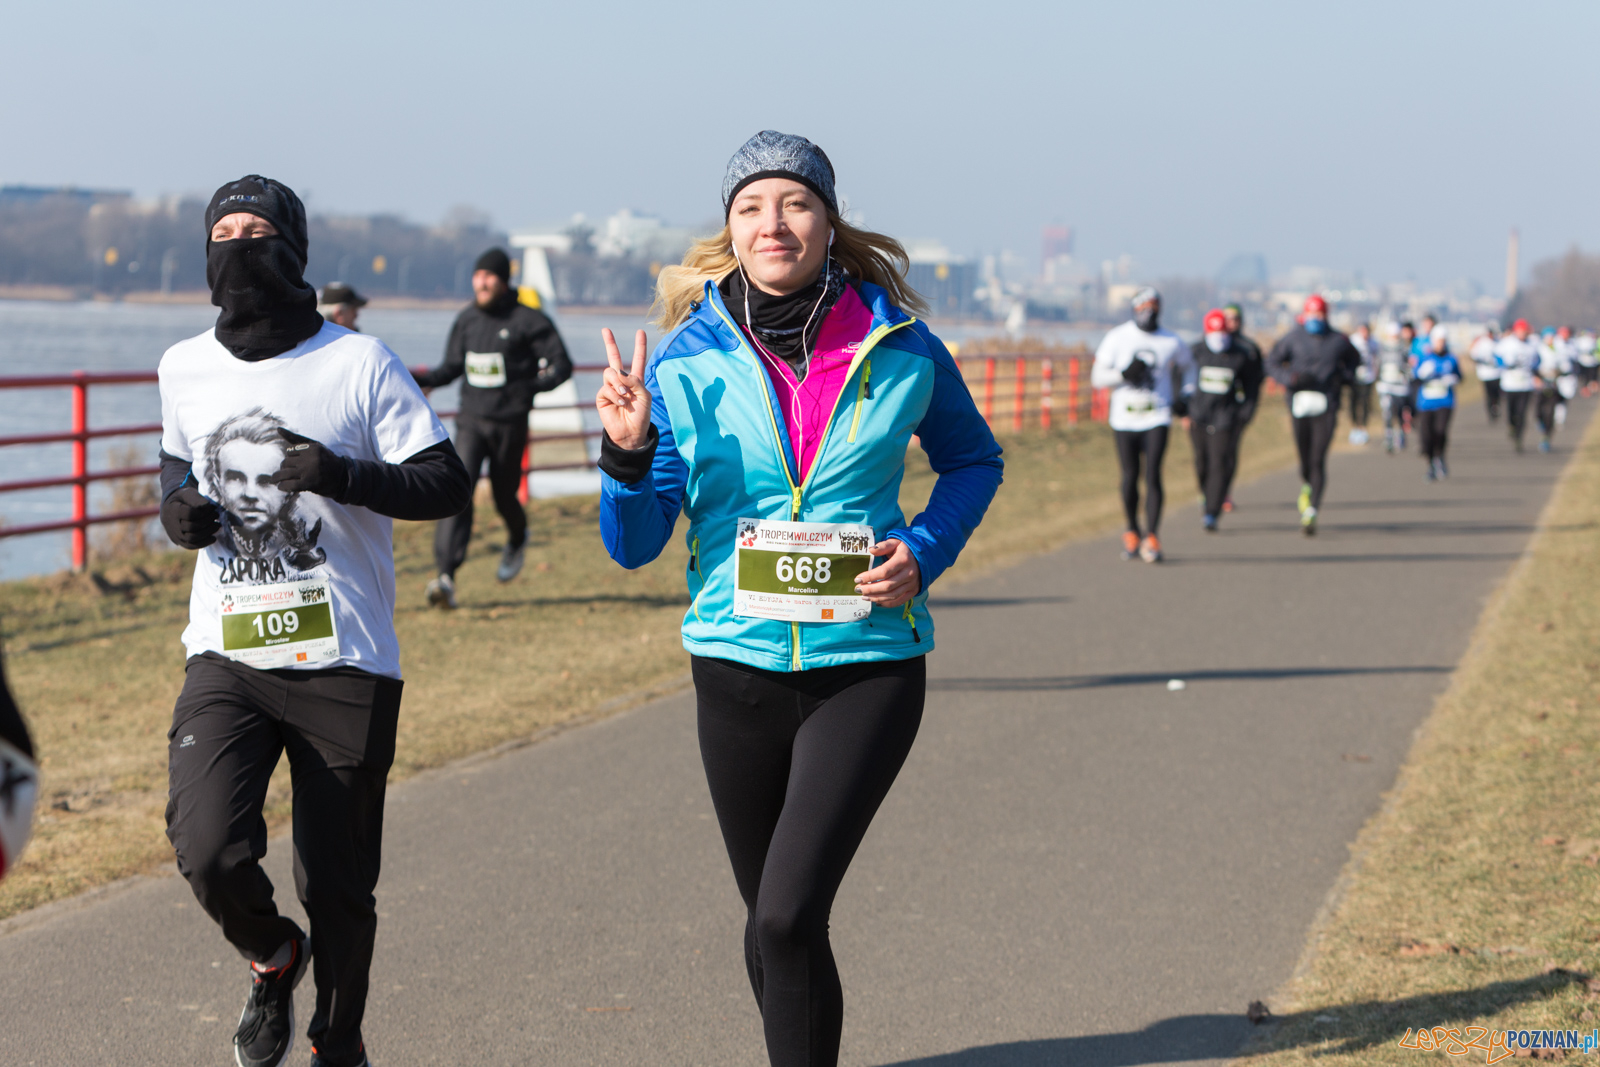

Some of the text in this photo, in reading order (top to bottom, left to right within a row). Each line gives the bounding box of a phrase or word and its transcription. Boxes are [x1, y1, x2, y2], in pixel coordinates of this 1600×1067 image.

[218, 556, 287, 584] ZAPORA
[776, 555, 832, 584] 668
[788, 586, 818, 594] Marcelina
[252, 610, 299, 638] 109
